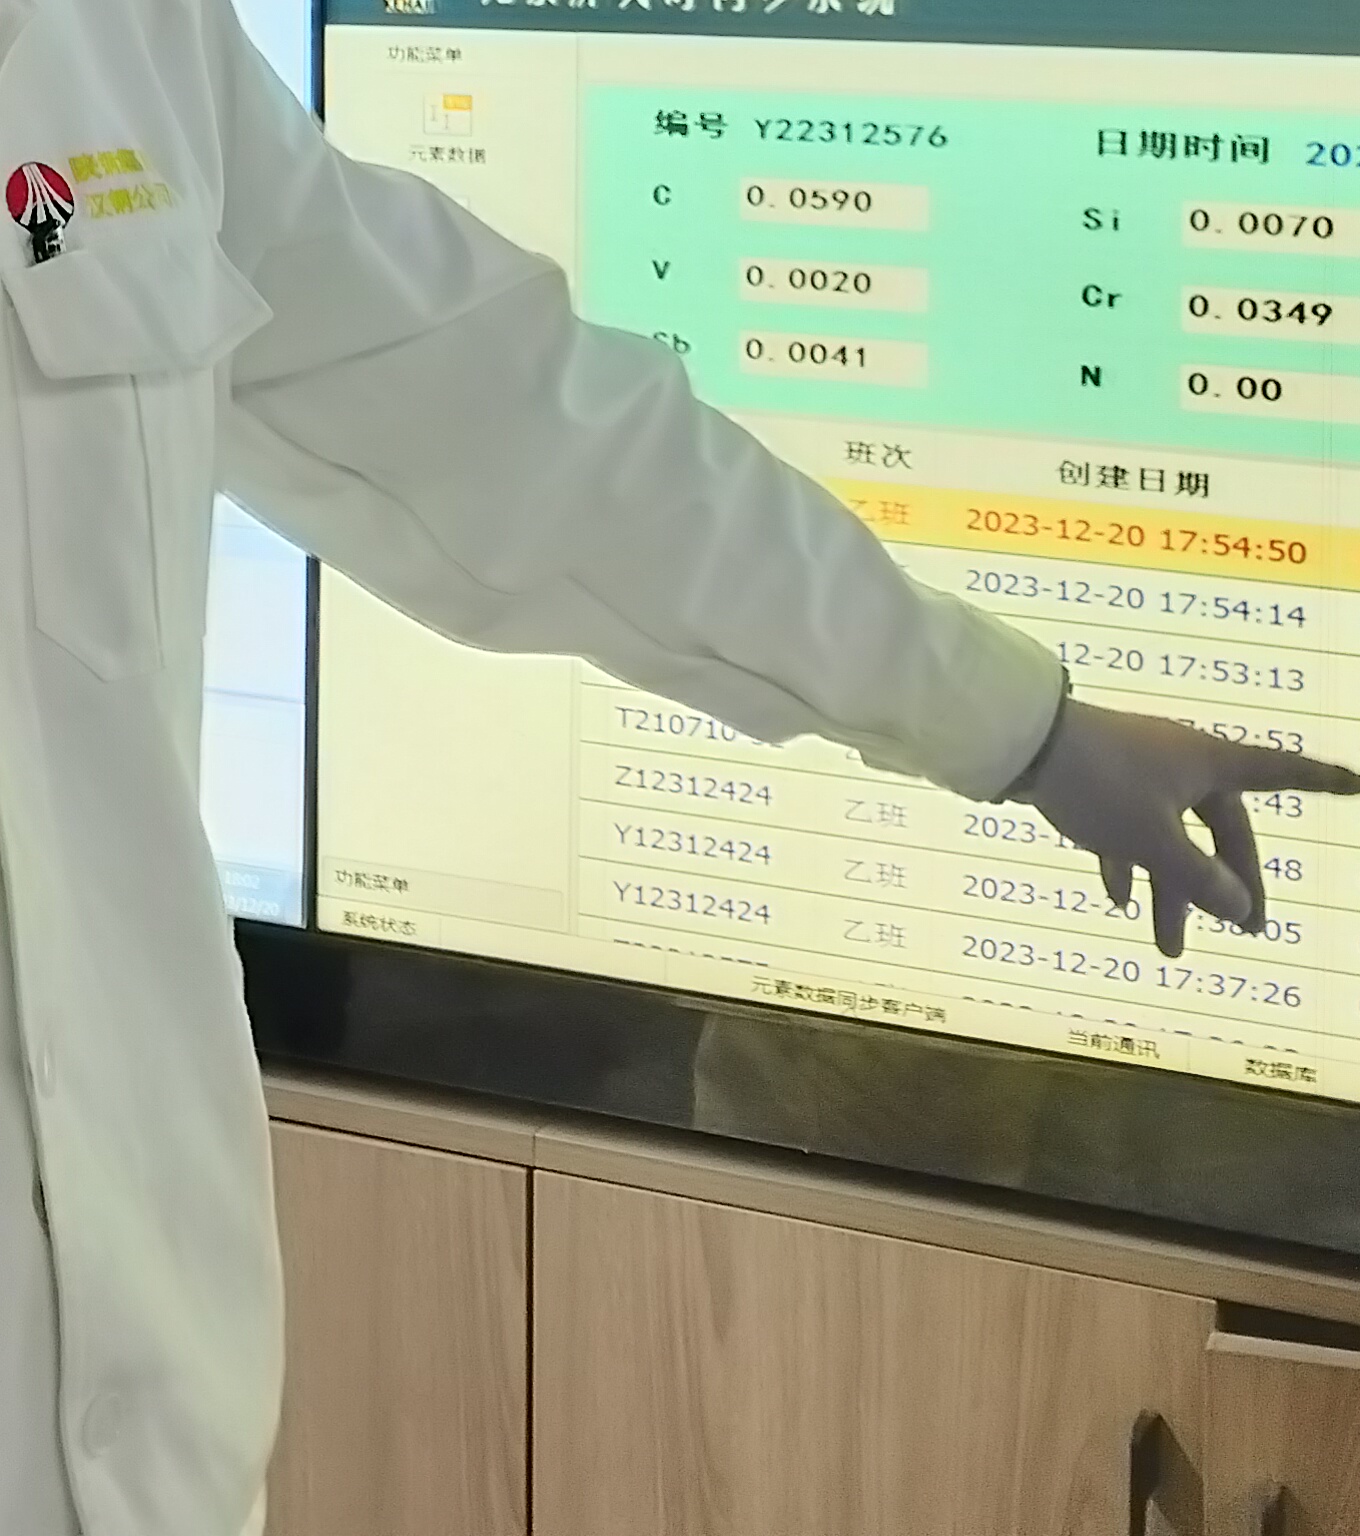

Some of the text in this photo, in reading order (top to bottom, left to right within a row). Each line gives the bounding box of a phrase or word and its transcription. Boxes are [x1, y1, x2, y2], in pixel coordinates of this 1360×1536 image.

[387, 45, 463, 65] 功能菜单
[654, 109, 950, 150] 编号 Y22312576
[1097, 127, 1270, 165] 日期时间
[409, 144, 488, 164] 元素数据
[652, 183, 873, 214] C 0.0590
[1082, 207, 1334, 240] Si 0.0070
[651, 259, 873, 295] V 0.0020
[1081, 283, 1334, 329] Cr 0.0349
[746, 337, 869, 369] 0.0041
[1080, 364, 1284, 404] N 0.00
[845, 439, 914, 471] 班次
[1056, 459, 1210, 499] 创建日期
[966, 508, 1146, 548] 2023-12-20
[1159, 528, 1307, 566] 17:54:50
[966, 569, 1145, 610] 2023-12-20
[1160, 591, 1306, 629] 17:54:14
[1056, 640, 1144, 673] 12-20
[1160, 654, 1305, 693] 17:53:13
[614, 764, 773, 807] Z12312424
[844, 798, 908, 830] 乙班
[334, 869, 410, 895] 功能菜单
[614, 823, 773, 866] Y12312424
[843, 858, 908, 891] 乙班
[962, 875, 1141, 920] 2023-12-20
[342, 910, 417, 937] 系统状态
[613, 881, 772, 925] Y12312424
[843, 918, 908, 951] 乙班
[961, 935, 1141, 984] 2023-12-20
[1155, 964, 1302, 1009] 17:37:26
[751, 974, 947, 1024] 元素数据同步客户端
[1067, 1027, 1160, 1061] 当前通讯
[1244, 1059, 1318, 1085] 数据库
